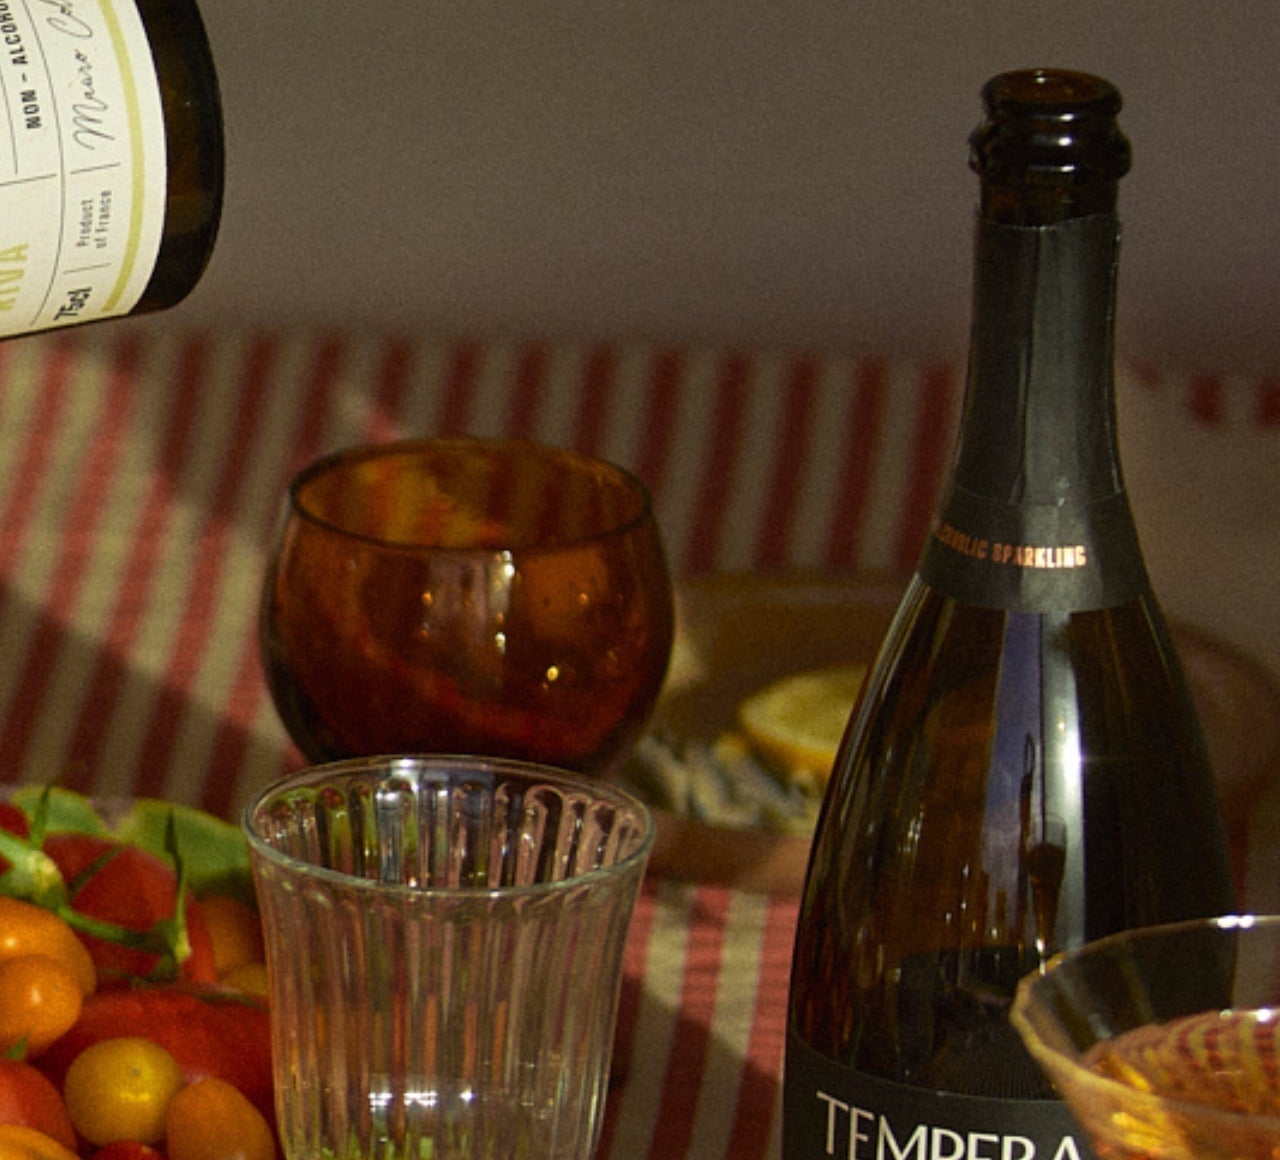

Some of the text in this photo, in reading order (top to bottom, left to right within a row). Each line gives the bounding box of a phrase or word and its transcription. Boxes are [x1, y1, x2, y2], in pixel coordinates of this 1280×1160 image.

[20, 89, 42, 129] NON
[75, 199, 94, 247] Product
[94, 190, 113, 249] of France
[53, 286, 93, 321] 75cl
[992, 543, 1087, 568] SPARKLING
